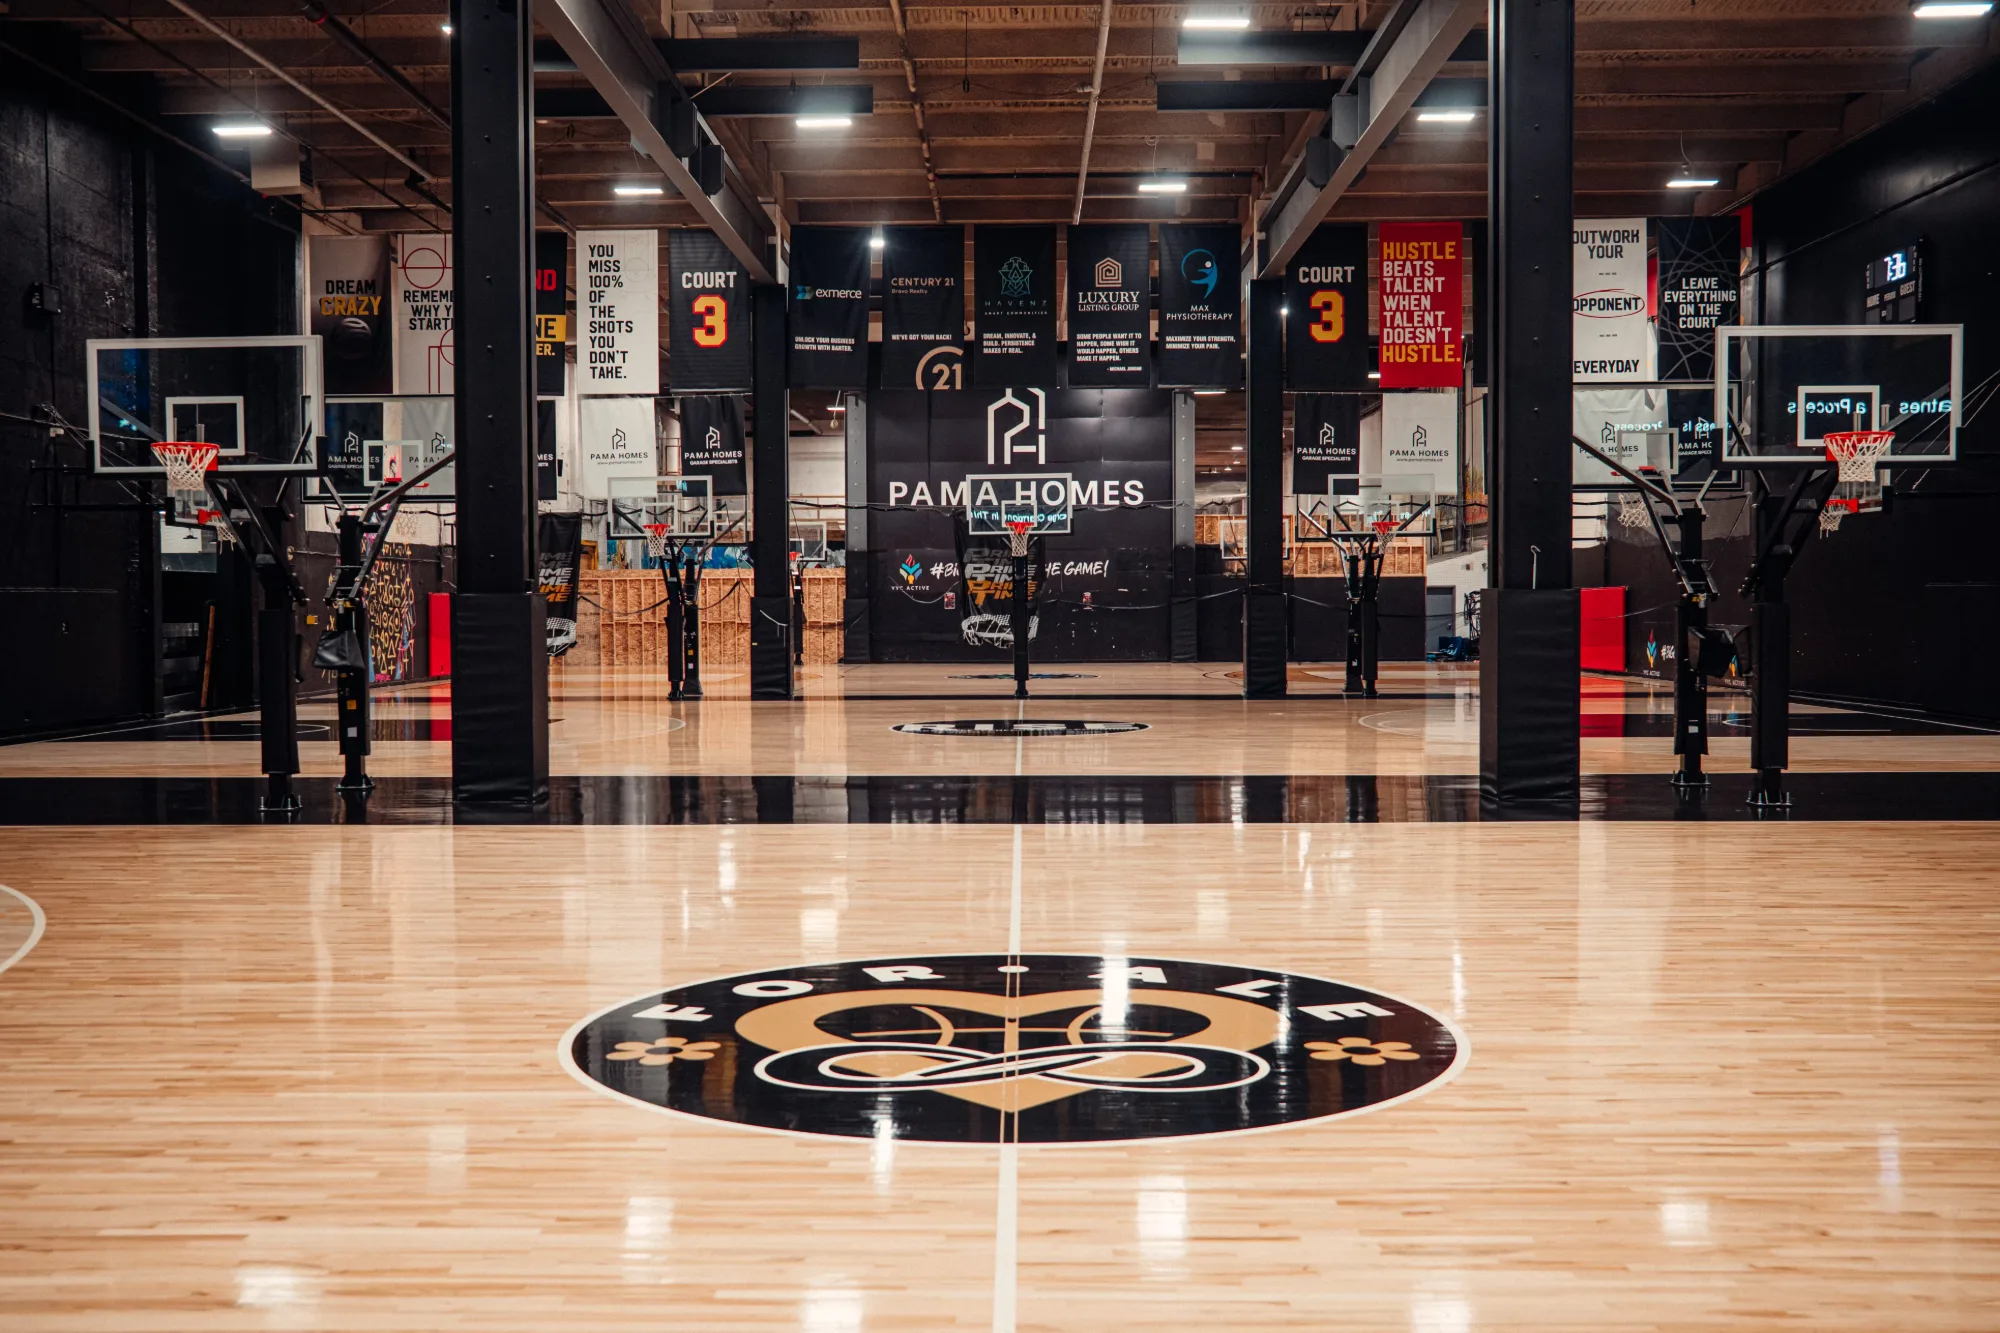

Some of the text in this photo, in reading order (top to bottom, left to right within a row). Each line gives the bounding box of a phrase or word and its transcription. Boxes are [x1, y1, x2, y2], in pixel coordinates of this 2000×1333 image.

[1573, 230, 1640, 245] OUTWORK
[588, 244, 614, 258] YOU
[1383, 242, 1456, 259] HUSTLE
[1588, 245, 1623, 259] YOUR
[589, 260, 621, 273] MISS
[1383, 261, 1434, 276] BEATS
[589, 275, 623, 288] 100%
[682, 272, 737, 288] COURT
[891, 277, 954, 286] CENTURY 21
[1299, 266, 1354, 283] COURT
[325, 280, 376, 294] DREAM
[1383, 277, 1445, 293] TALENT
[1682, 277, 1718, 290] LEAVE
[589, 290, 605, 303] OF
[816, 286, 862, 298] exmerce
[1078, 292, 1140, 303] LUXURY
[1664, 290, 1736, 303] EVERYTHING
[320, 296, 382, 316] CRAZY
[1112, 303, 1139, 311] GROUP
[1383, 294, 1431, 310] WHEN
[1573, 297, 1640, 311] OPPONENT
[411, 304, 440, 317] WHY
[589, 306, 616, 318] THE
[1310, 289, 1344, 343] 3
[1679, 304, 1721, 316] ON THE
[409, 318, 453, 330] START
[692, 294, 728, 348] 3
[1383, 311, 1445, 327] TALENT
[1679, 317, 1718, 328] COURT
[589, 320, 633, 333] SHOTS
[589, 336, 615, 348] YOU
[1383, 327, 1452, 344] DOESN'T
[590, 351, 628, 364] DON'T
[1382, 344, 1461, 362] HUSTLE.
[590, 366, 627, 379] TAKE.
[1573, 360, 1640, 374] EVERYDAY
[1326, 447, 1356, 455] HOMES
[889, 480, 1144, 506] PAMA HOMES
[1064, 560, 1109, 577] GAME!
